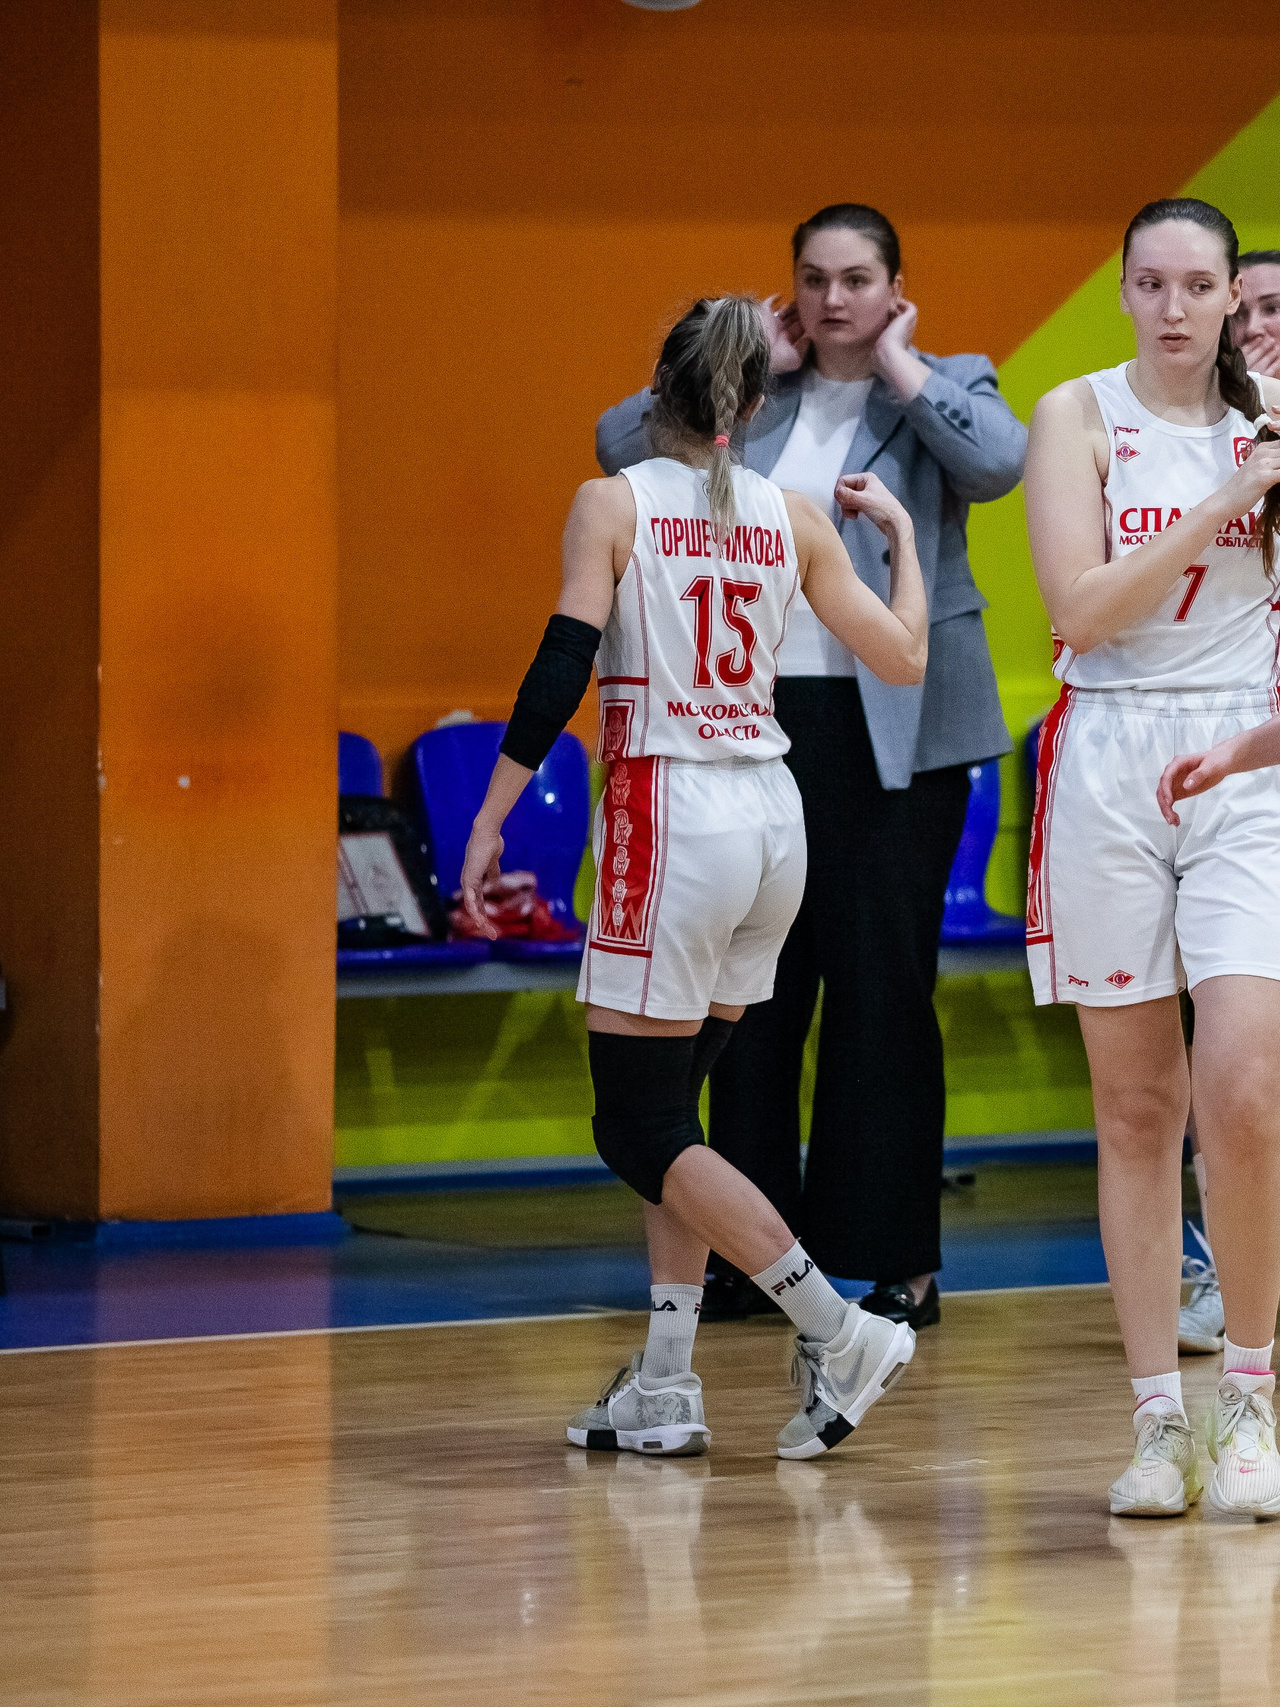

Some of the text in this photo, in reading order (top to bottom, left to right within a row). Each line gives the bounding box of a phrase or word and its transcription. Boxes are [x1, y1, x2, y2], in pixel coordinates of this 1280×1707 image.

[1119, 507, 1264, 536] СПААК
[1215, 536, 1264, 548] ОБЛАСТ
[1173, 564, 1210, 622] 7
[680, 575, 762, 689] 15
[667, 701, 774, 721] МОКОВСКА
[770, 1258, 815, 1297] FILA
